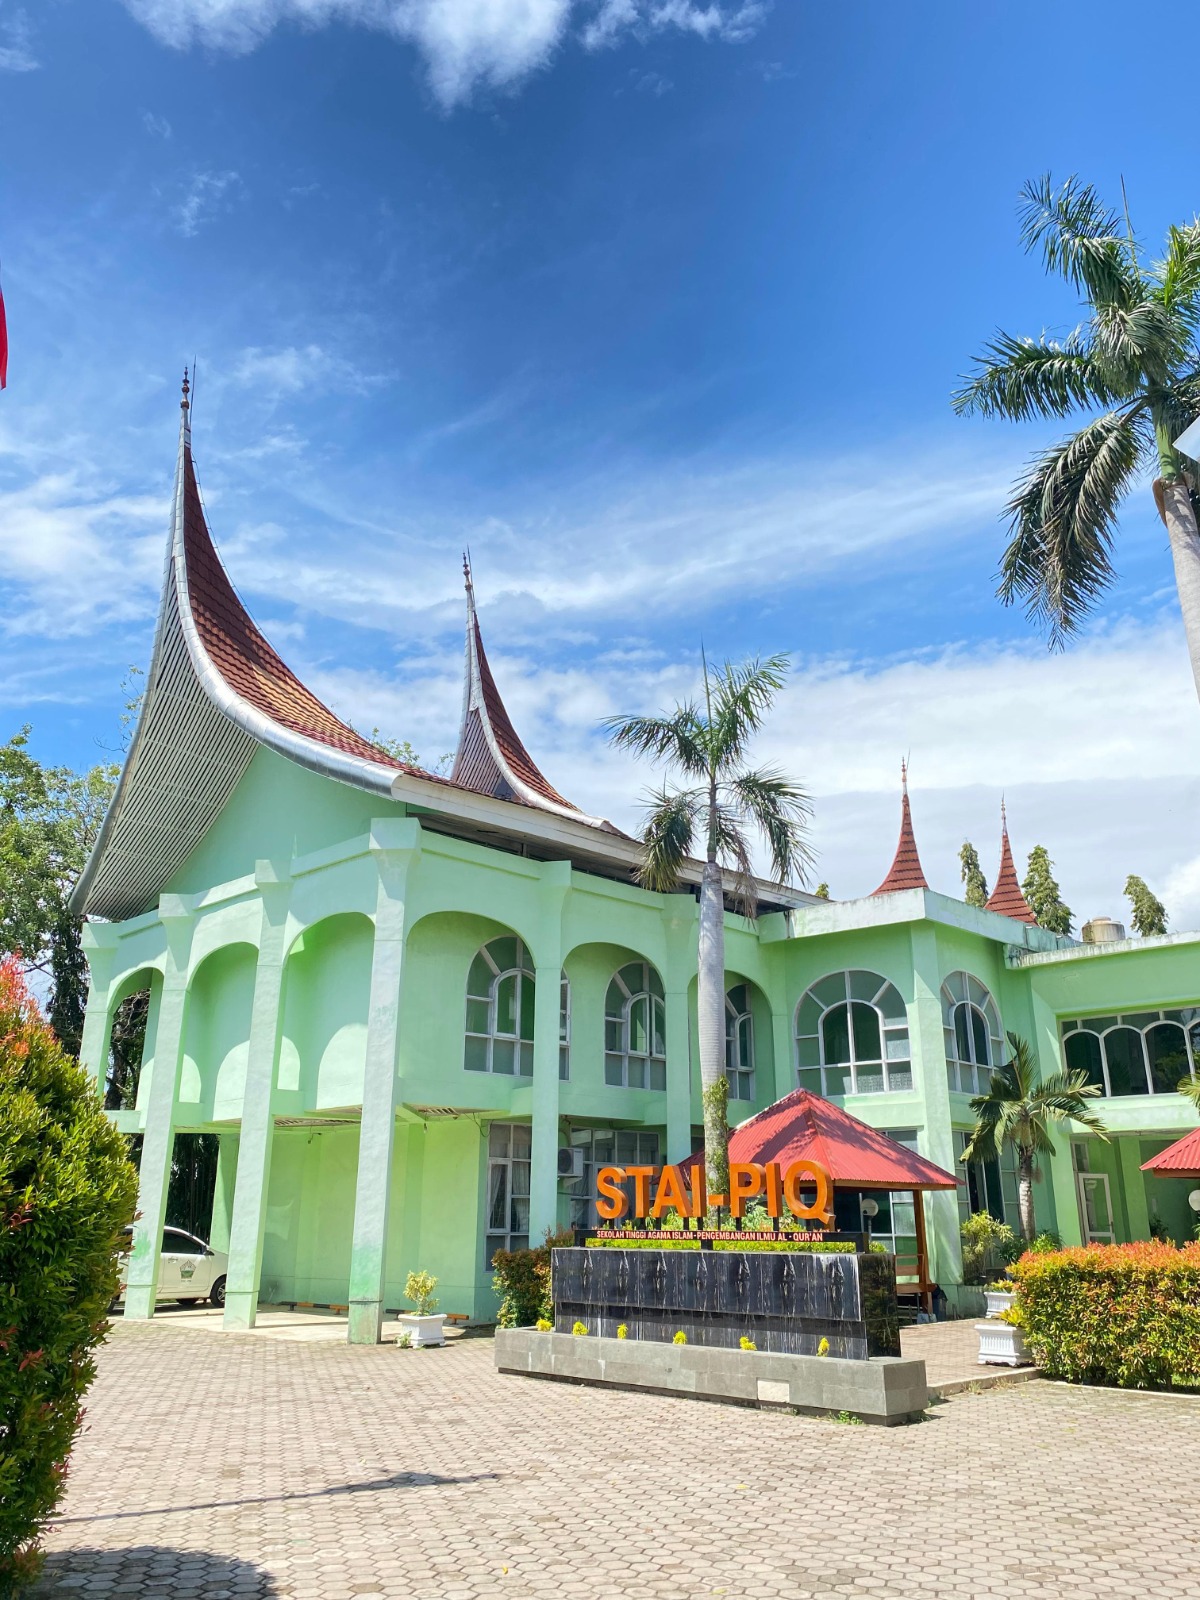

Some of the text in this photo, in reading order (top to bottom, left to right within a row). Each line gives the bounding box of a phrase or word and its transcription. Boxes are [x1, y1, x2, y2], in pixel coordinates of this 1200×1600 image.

[595, 1160, 834, 1225] STAI-PIQ
[597, 1230, 624, 1239] SEKOLAH
[625, 1230, 647, 1239] TINGGI
[647, 1231, 671, 1240] AGAMA
[757, 1232, 776, 1241] ILMU
